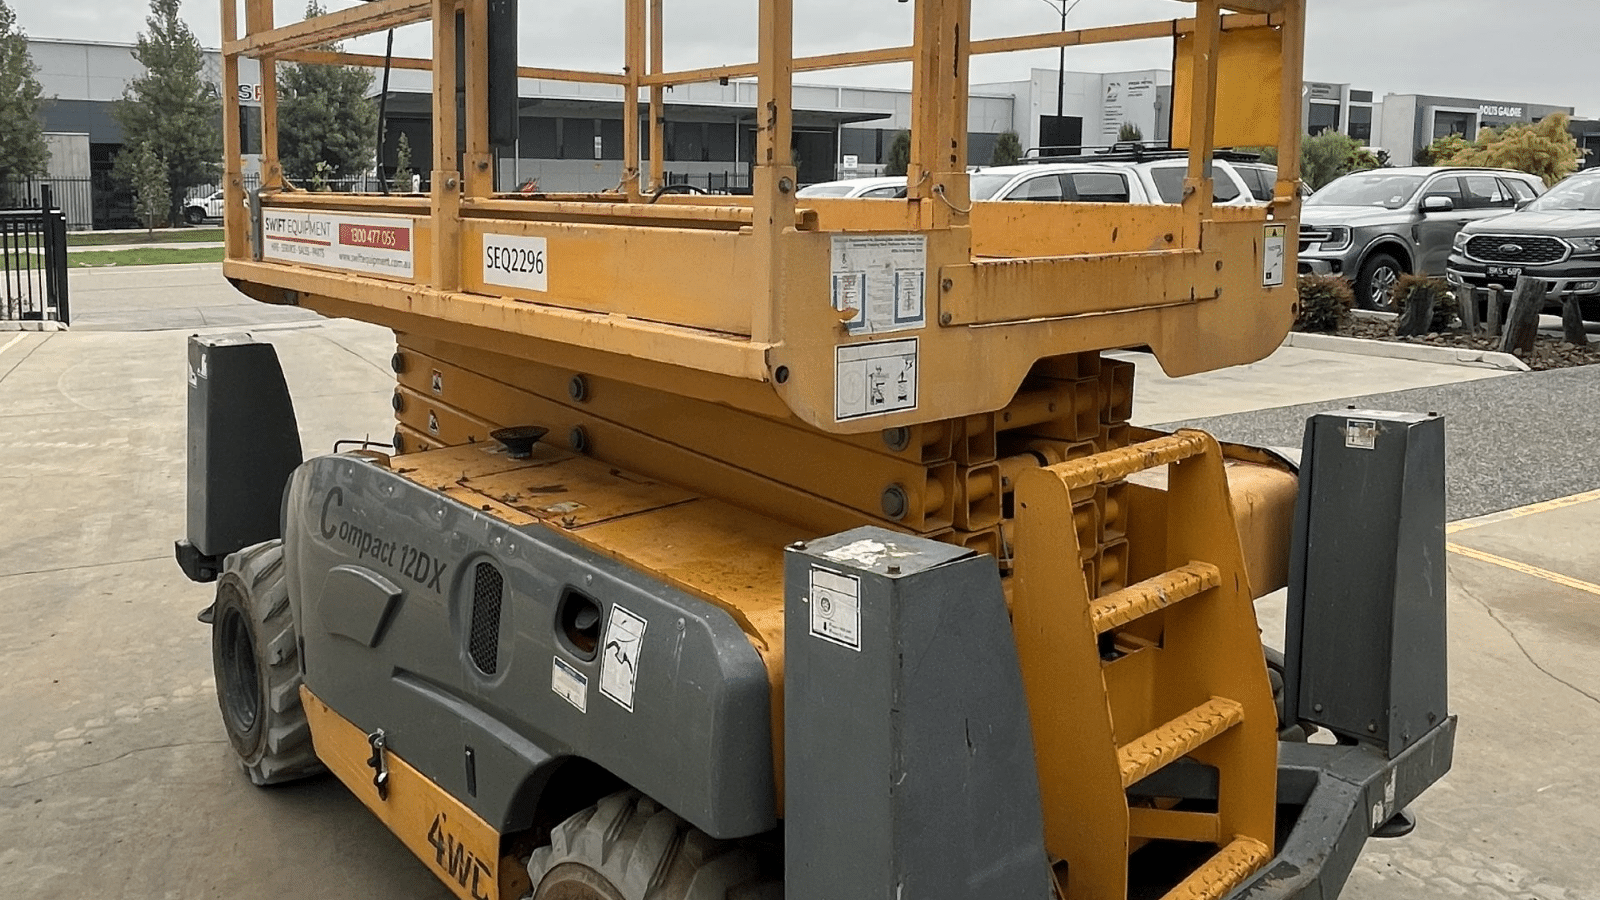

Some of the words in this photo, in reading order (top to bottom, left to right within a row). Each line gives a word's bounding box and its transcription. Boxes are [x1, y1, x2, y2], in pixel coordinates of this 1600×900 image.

[265, 217, 286, 231] SWIFT
[287, 219, 331, 237] EQUIPMENT
[351, 227, 367, 243] 1300
[367, 229, 381, 244] 477
[486, 245, 544, 275] SEQ2296
[320, 486, 397, 567] Compact
[399, 543, 447, 595] 12DX
